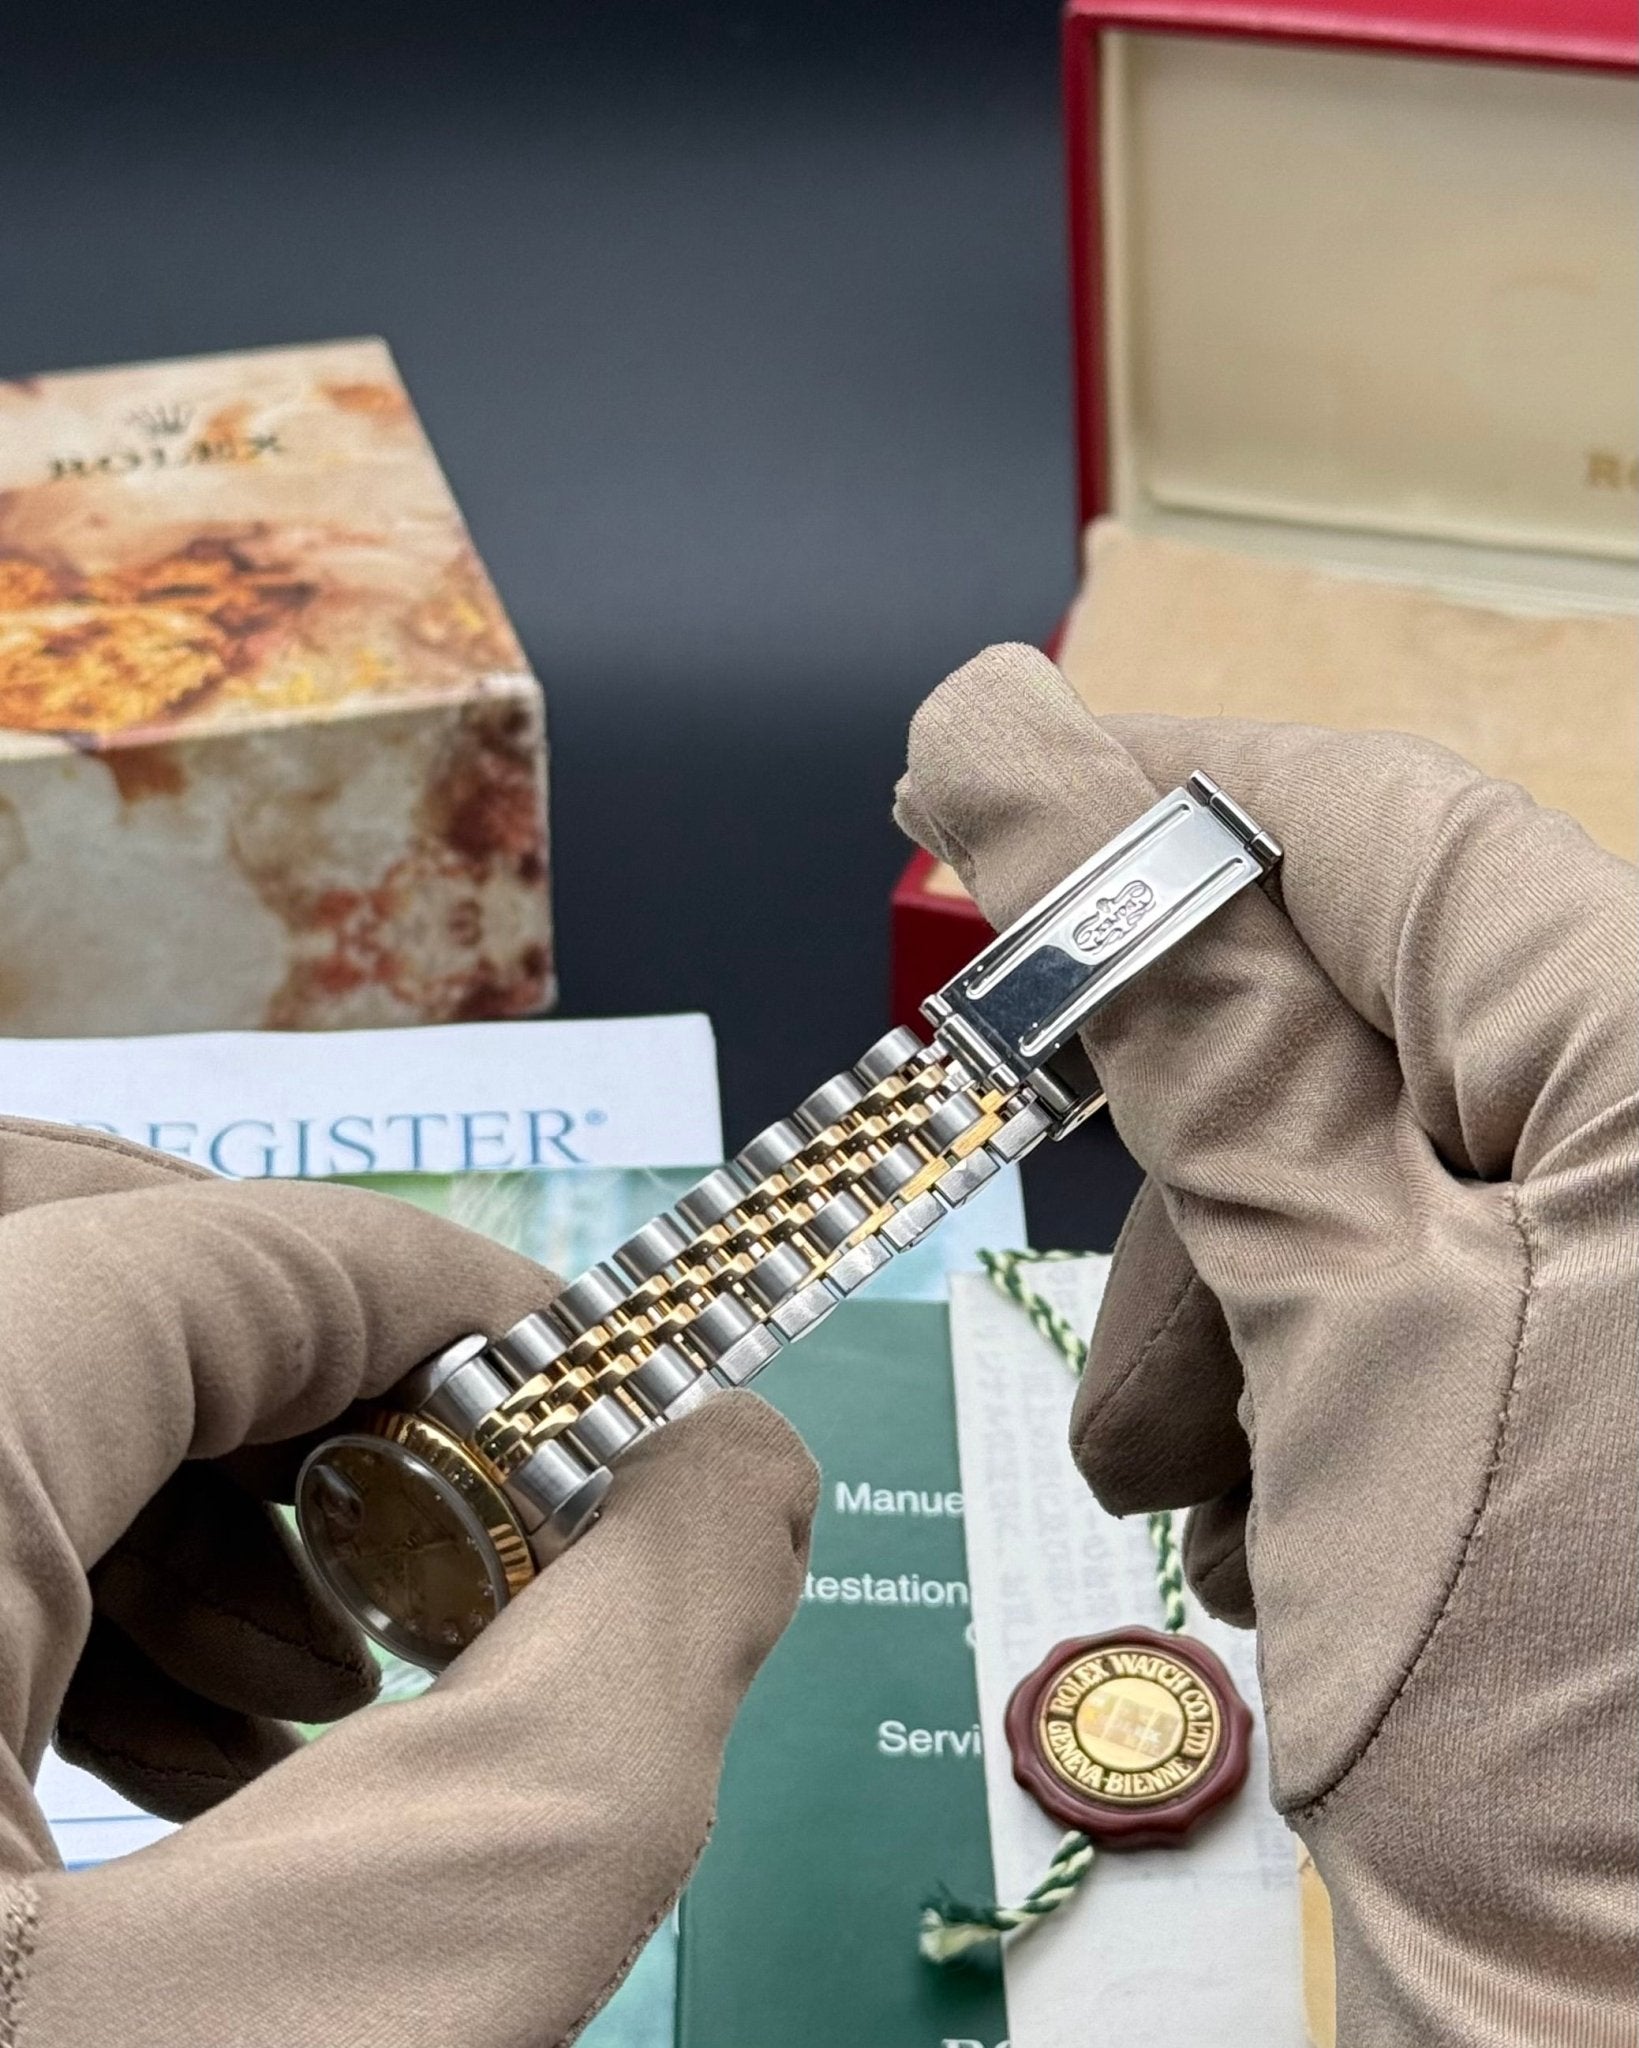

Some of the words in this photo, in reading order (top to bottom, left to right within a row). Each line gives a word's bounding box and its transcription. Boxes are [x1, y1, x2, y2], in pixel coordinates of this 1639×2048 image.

[800, 1571, 969, 1607] testation
[1050, 1658, 1110, 1715] ROLEX
[1107, 1653, 1193, 1696] WATCH
